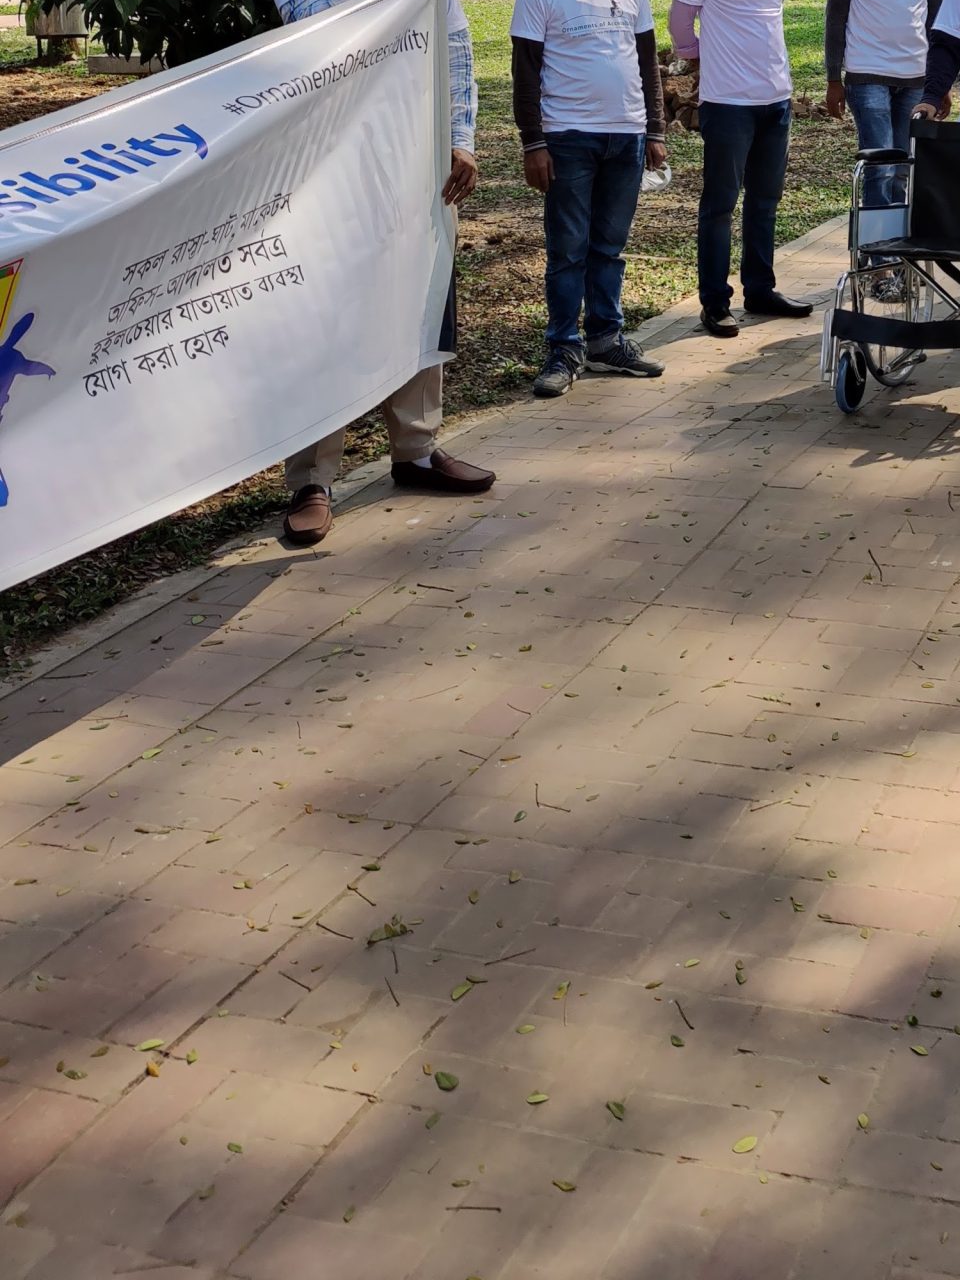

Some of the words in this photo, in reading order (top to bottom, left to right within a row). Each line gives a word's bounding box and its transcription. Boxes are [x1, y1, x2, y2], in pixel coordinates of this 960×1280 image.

[562, 23, 597, 33] Ornaments
[222, 30, 429, 115] #OrnamentsOfAccessibility
[0, 124, 209, 217] sibility
[122, 249, 169, 284] সকল
[254, 264, 305, 294] ব্যবস্থা
[82, 359, 132, 397] যোগ
[133, 343, 178, 375] করা
[180, 325, 229, 360] হোক
